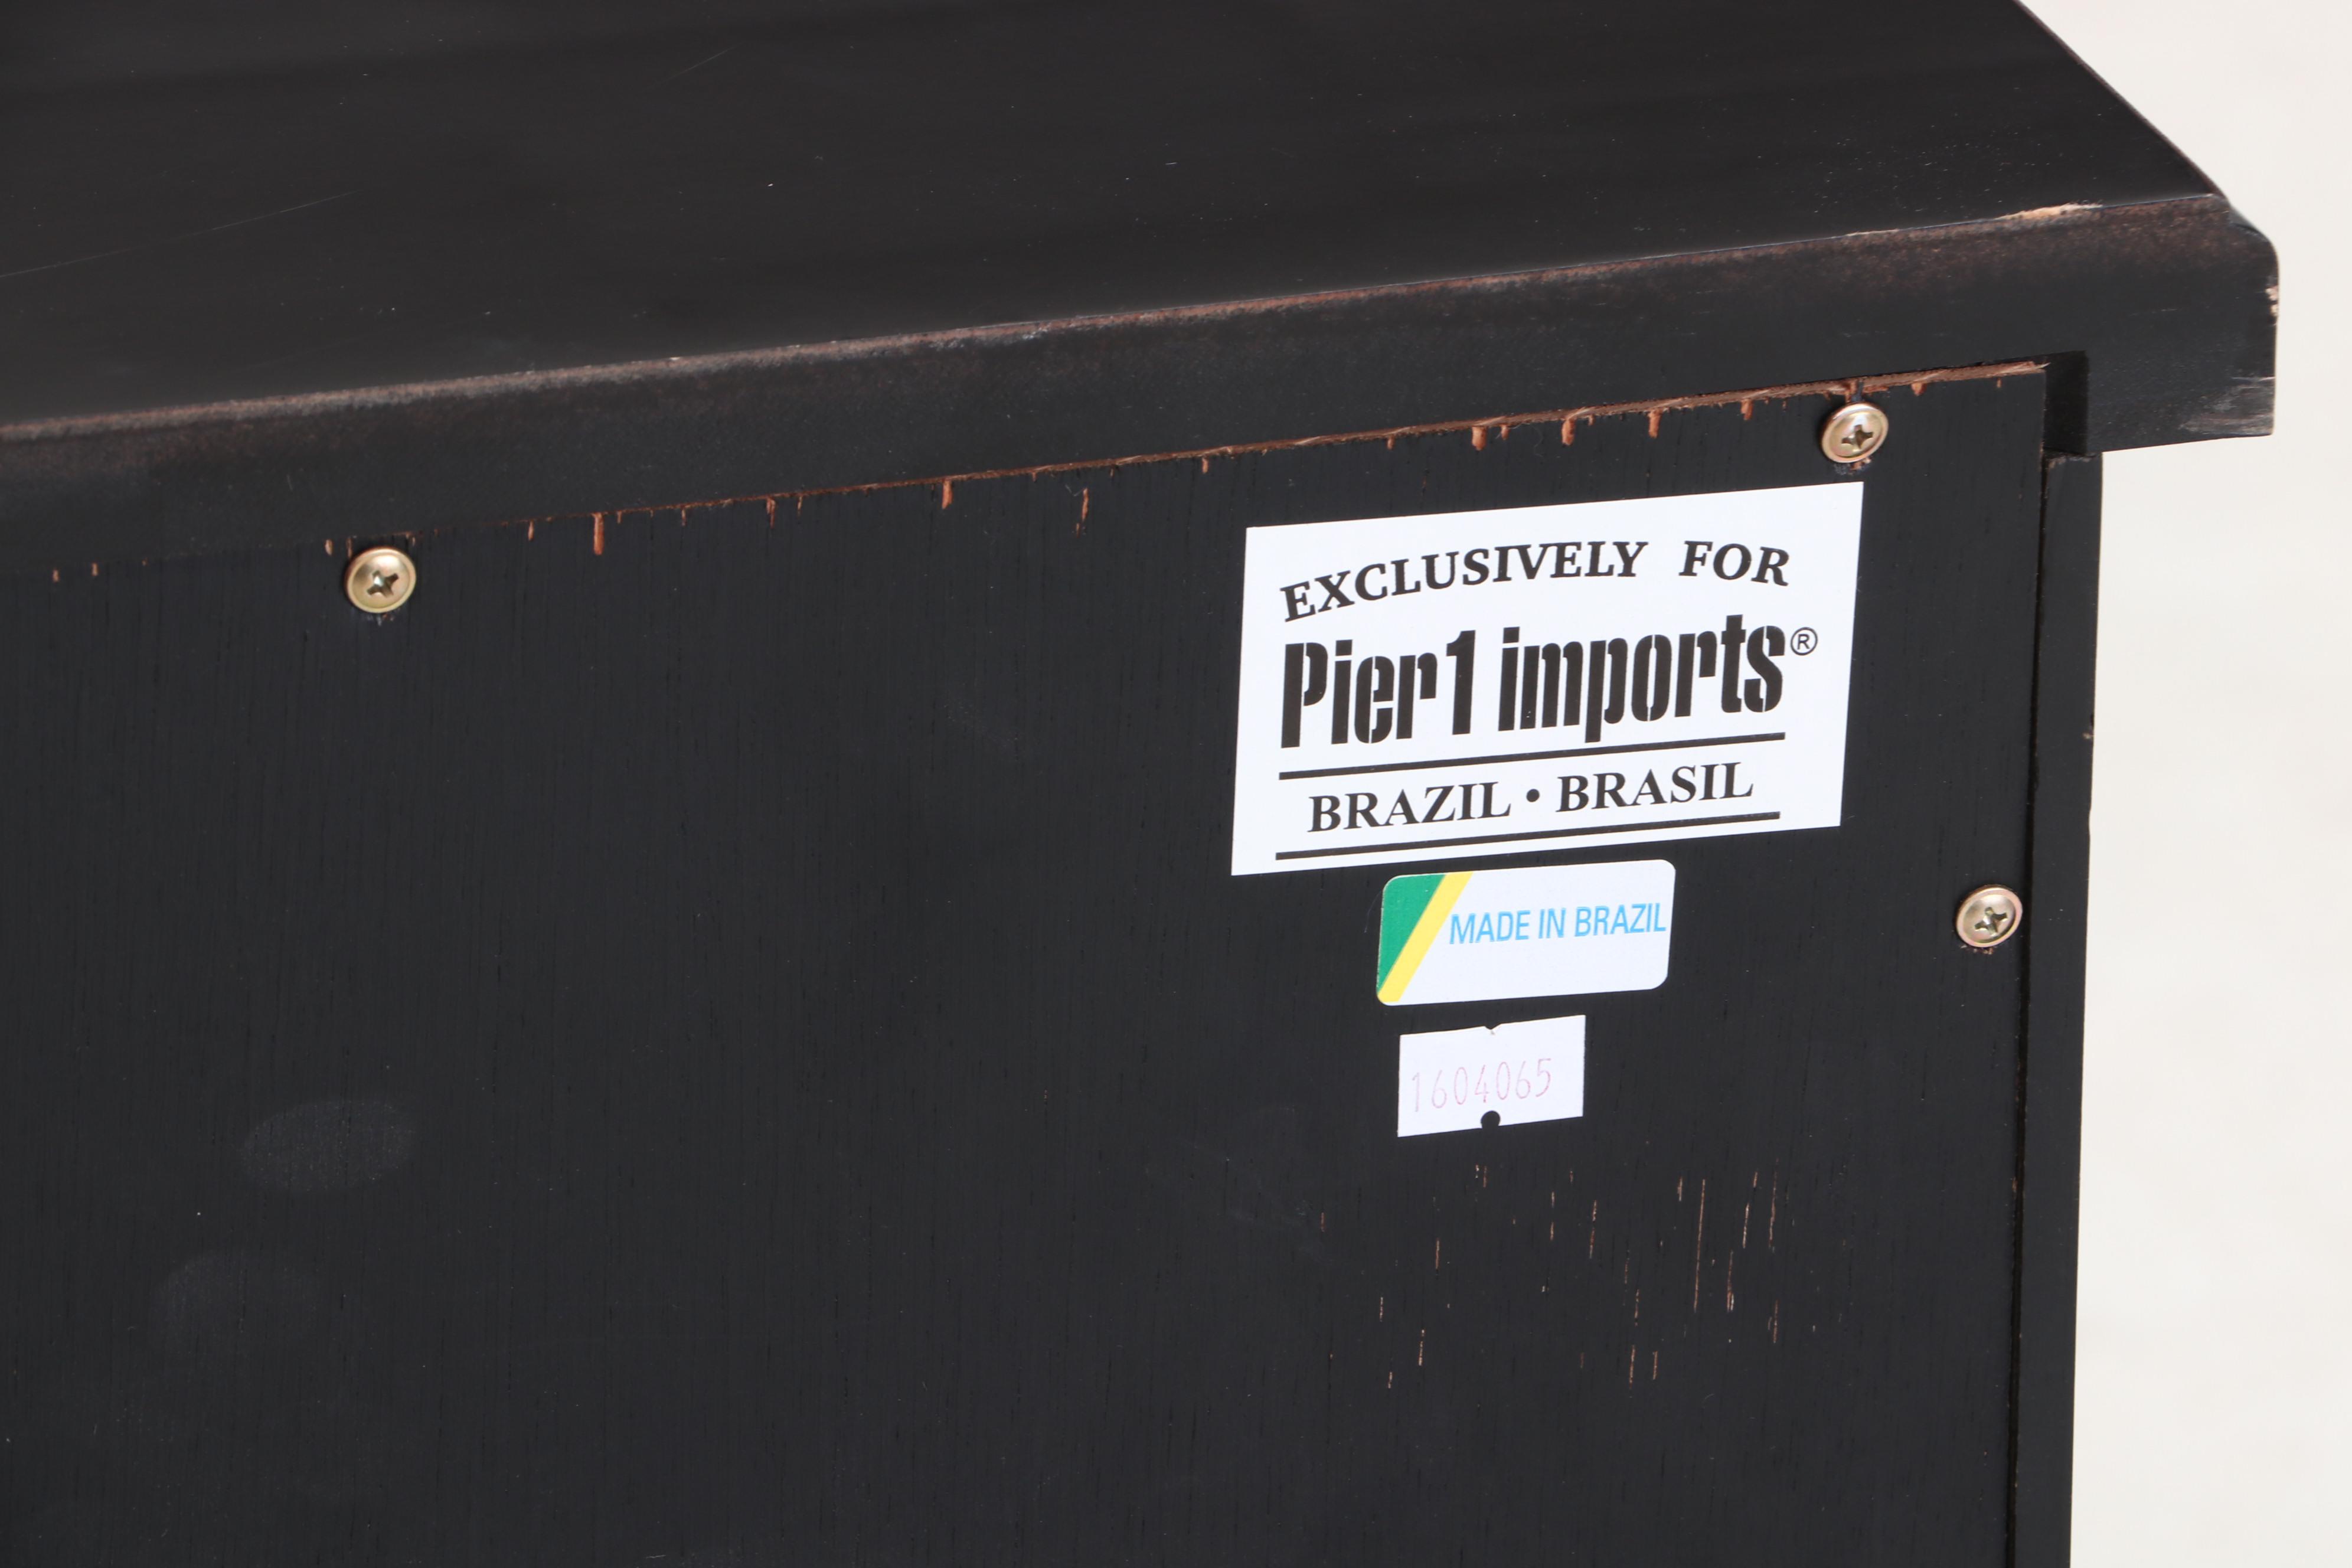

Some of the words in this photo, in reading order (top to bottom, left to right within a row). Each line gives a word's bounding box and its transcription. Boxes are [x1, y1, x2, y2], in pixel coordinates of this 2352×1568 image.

[1280, 541, 1648, 622] EXCLUSIVELY
[1679, 540, 1789, 586] FOR
[1307, 782, 1511, 832] BRAZIL
[1556, 762, 1753, 812] BRASIL
[1449, 910, 1531, 945] MADE
[1538, 907, 1566, 940] IN
[1574, 903, 1667, 937] BRAZIL
[1412, 1057, 1551, 1113] 1604065
